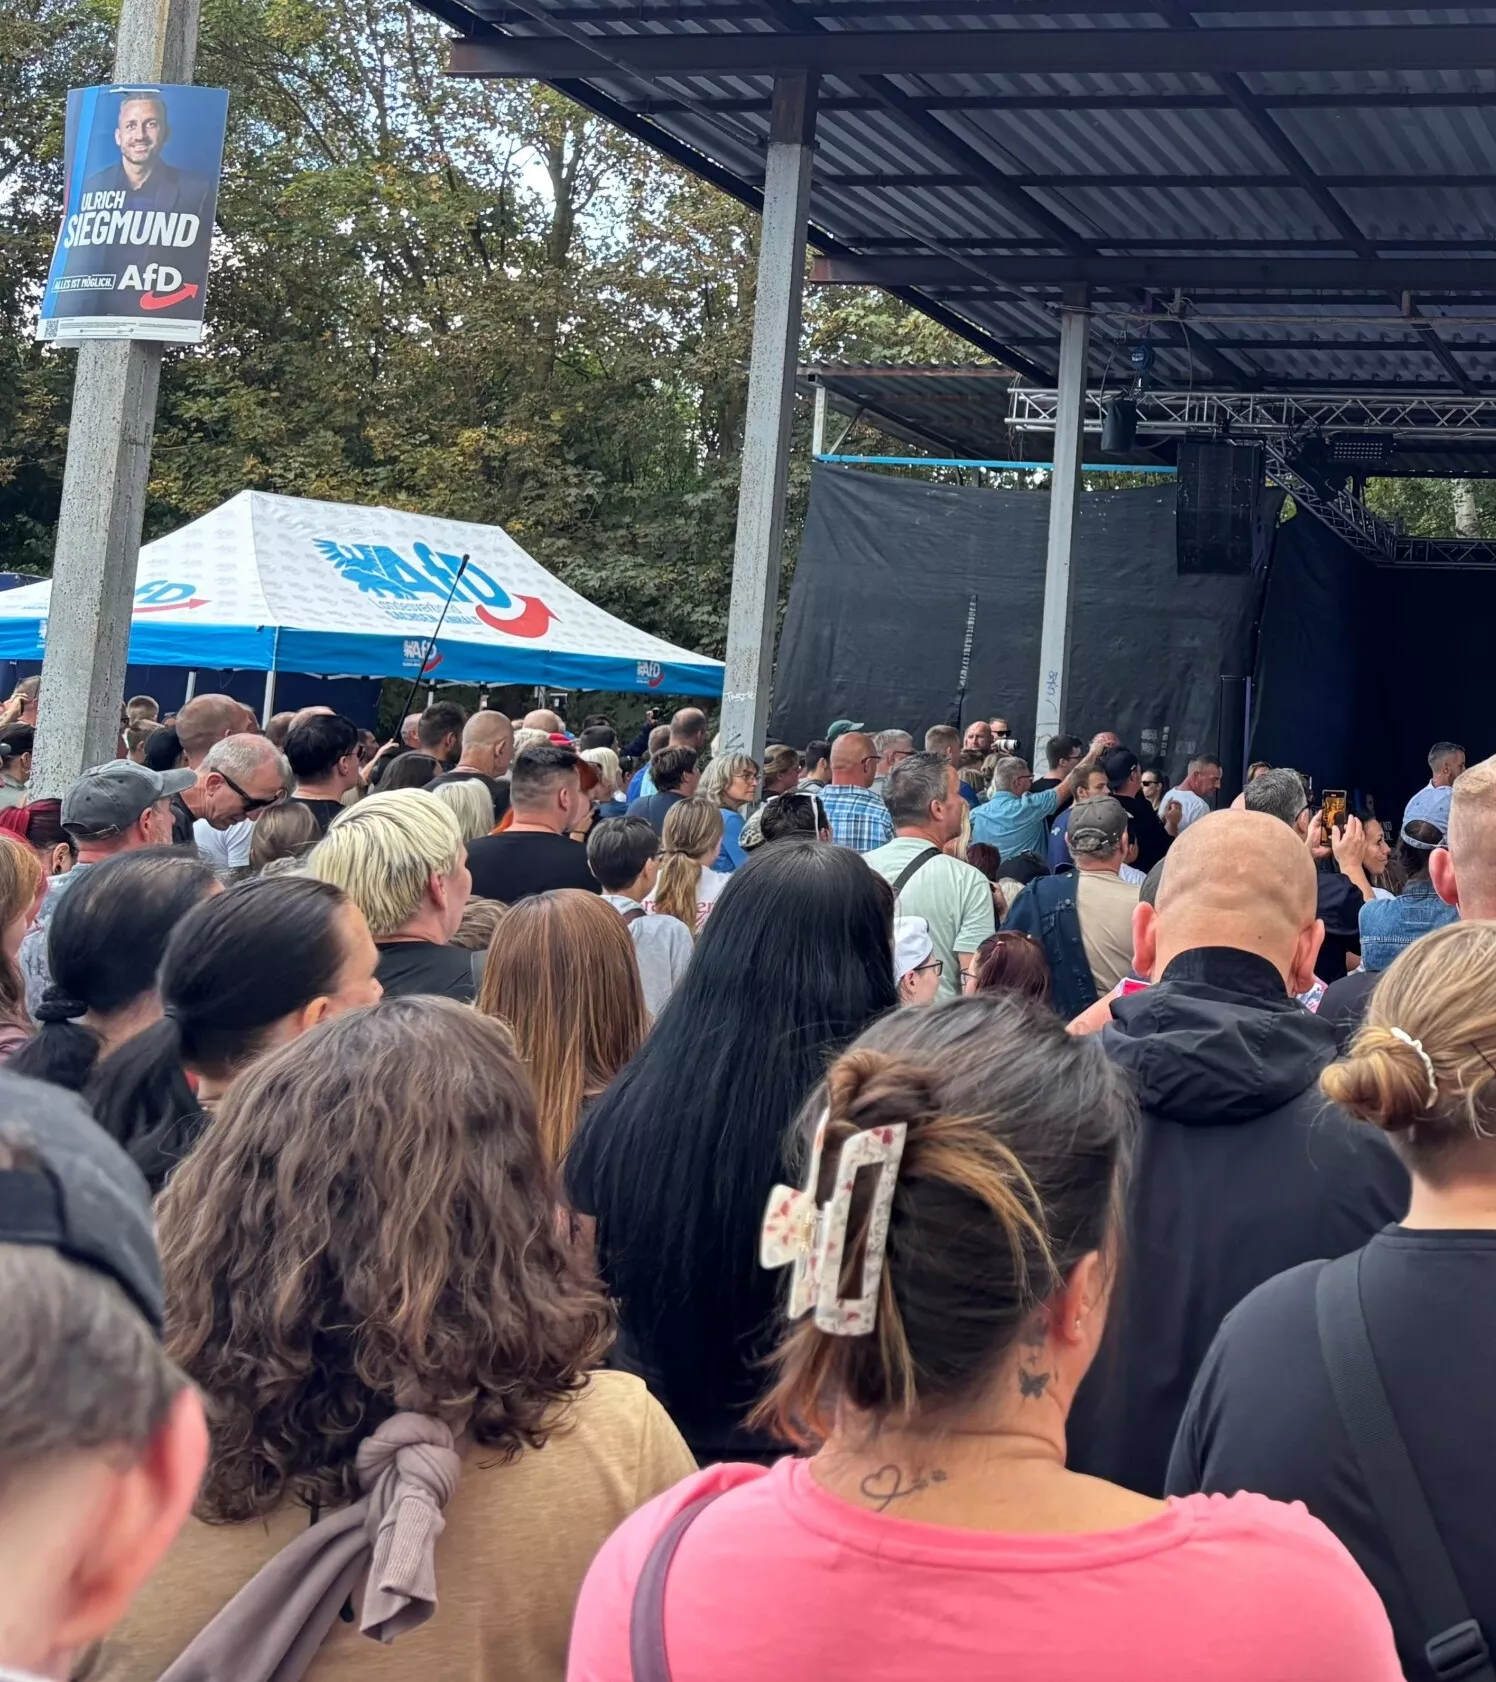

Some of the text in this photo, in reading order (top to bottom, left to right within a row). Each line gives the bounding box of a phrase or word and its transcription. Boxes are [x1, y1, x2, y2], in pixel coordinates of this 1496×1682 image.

[80, 190, 127, 211] ULRICH
[63, 210, 200, 249] SIEGMUND
[54, 275, 113, 290] ALLES IST MÖGLICH.
[117, 263, 183, 292] AfD
[135, 579, 197, 604] fD
